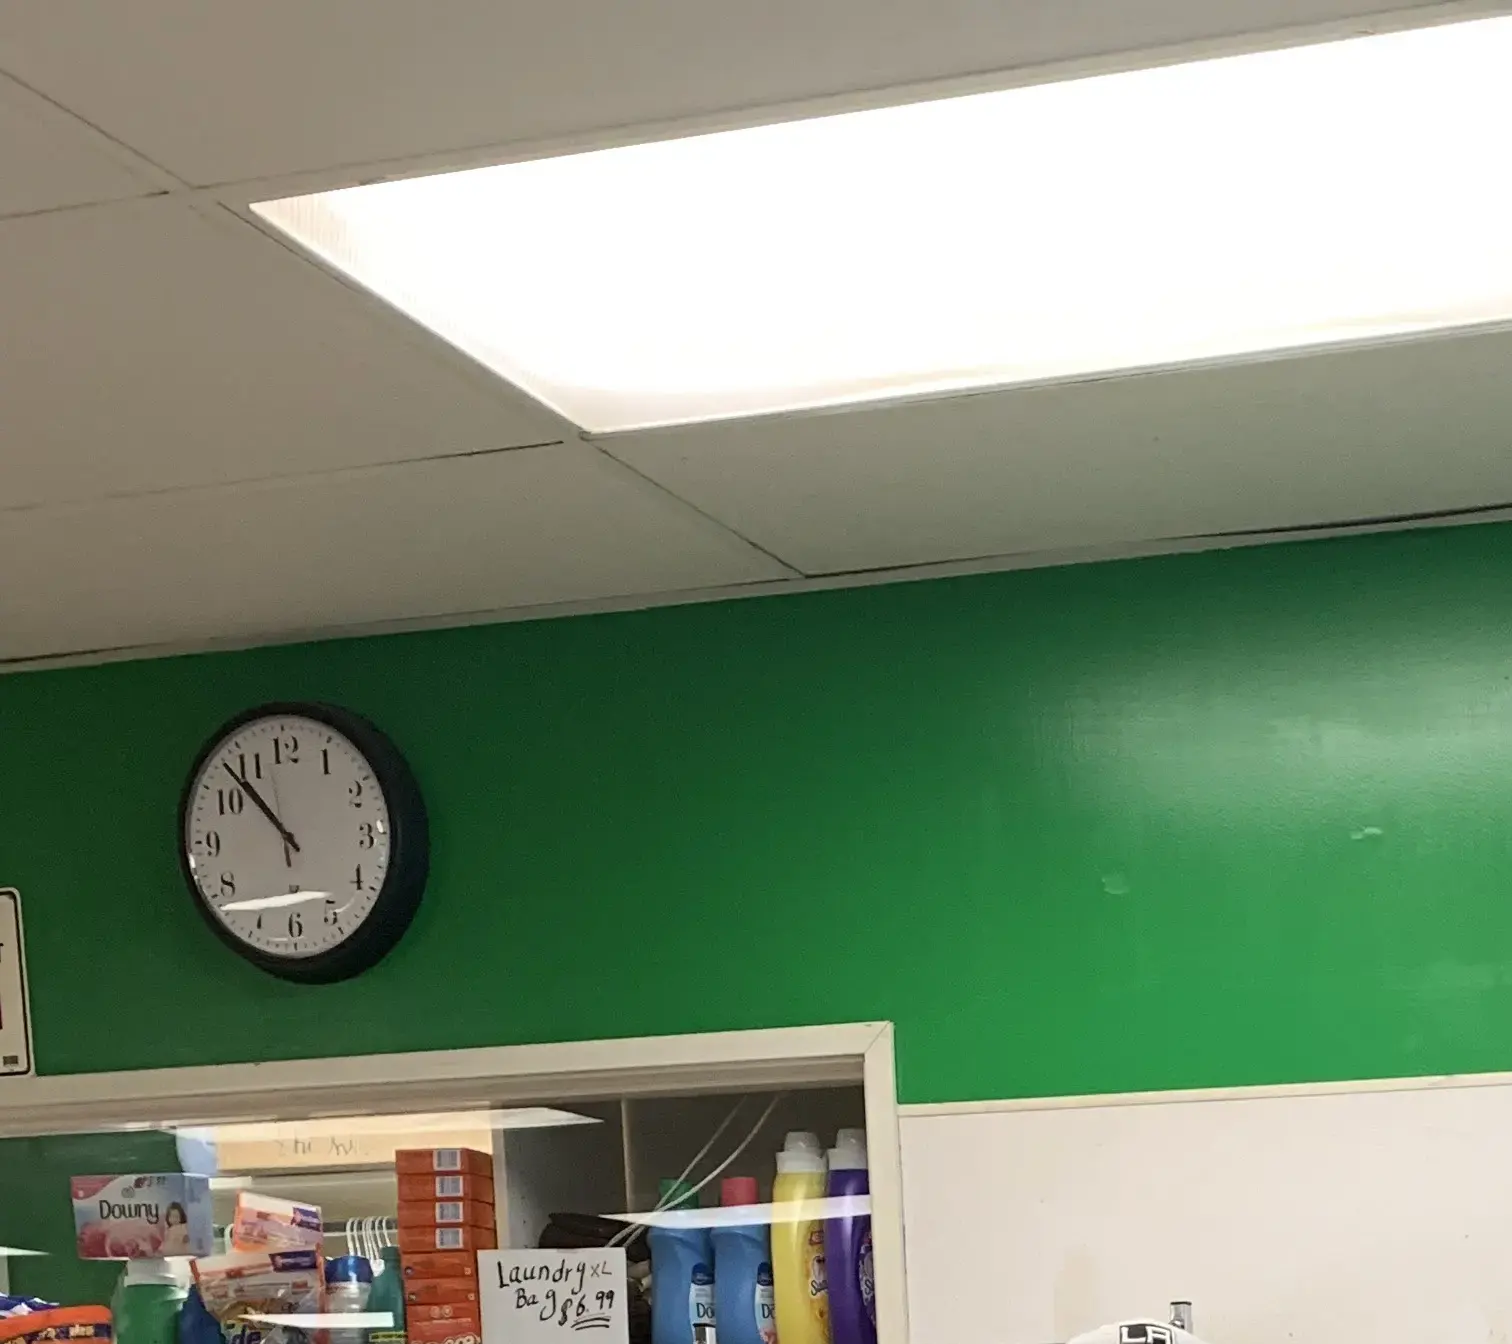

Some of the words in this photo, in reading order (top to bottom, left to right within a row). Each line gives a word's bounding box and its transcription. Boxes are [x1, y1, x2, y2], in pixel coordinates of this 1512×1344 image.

[272, 735, 299, 764] 12
[320, 749, 331, 775] 1
[239, 753, 263, 780] 11
[217, 788, 244, 816] 10
[348, 780, 363, 808] 2
[205, 831, 221, 858] 9
[359, 823, 374, 850] 3
[220, 870, 236, 898] 8
[349, 864, 364, 890] 4
[288, 912, 304, 938] 6
[324, 900, 338, 926] 5
[99, 1200, 159, 1224] Downy
[496, 1258, 587, 1301] Laundry
[515, 1287, 559, 1322] Bag
[558, 1290, 615, 1326] $6.99
